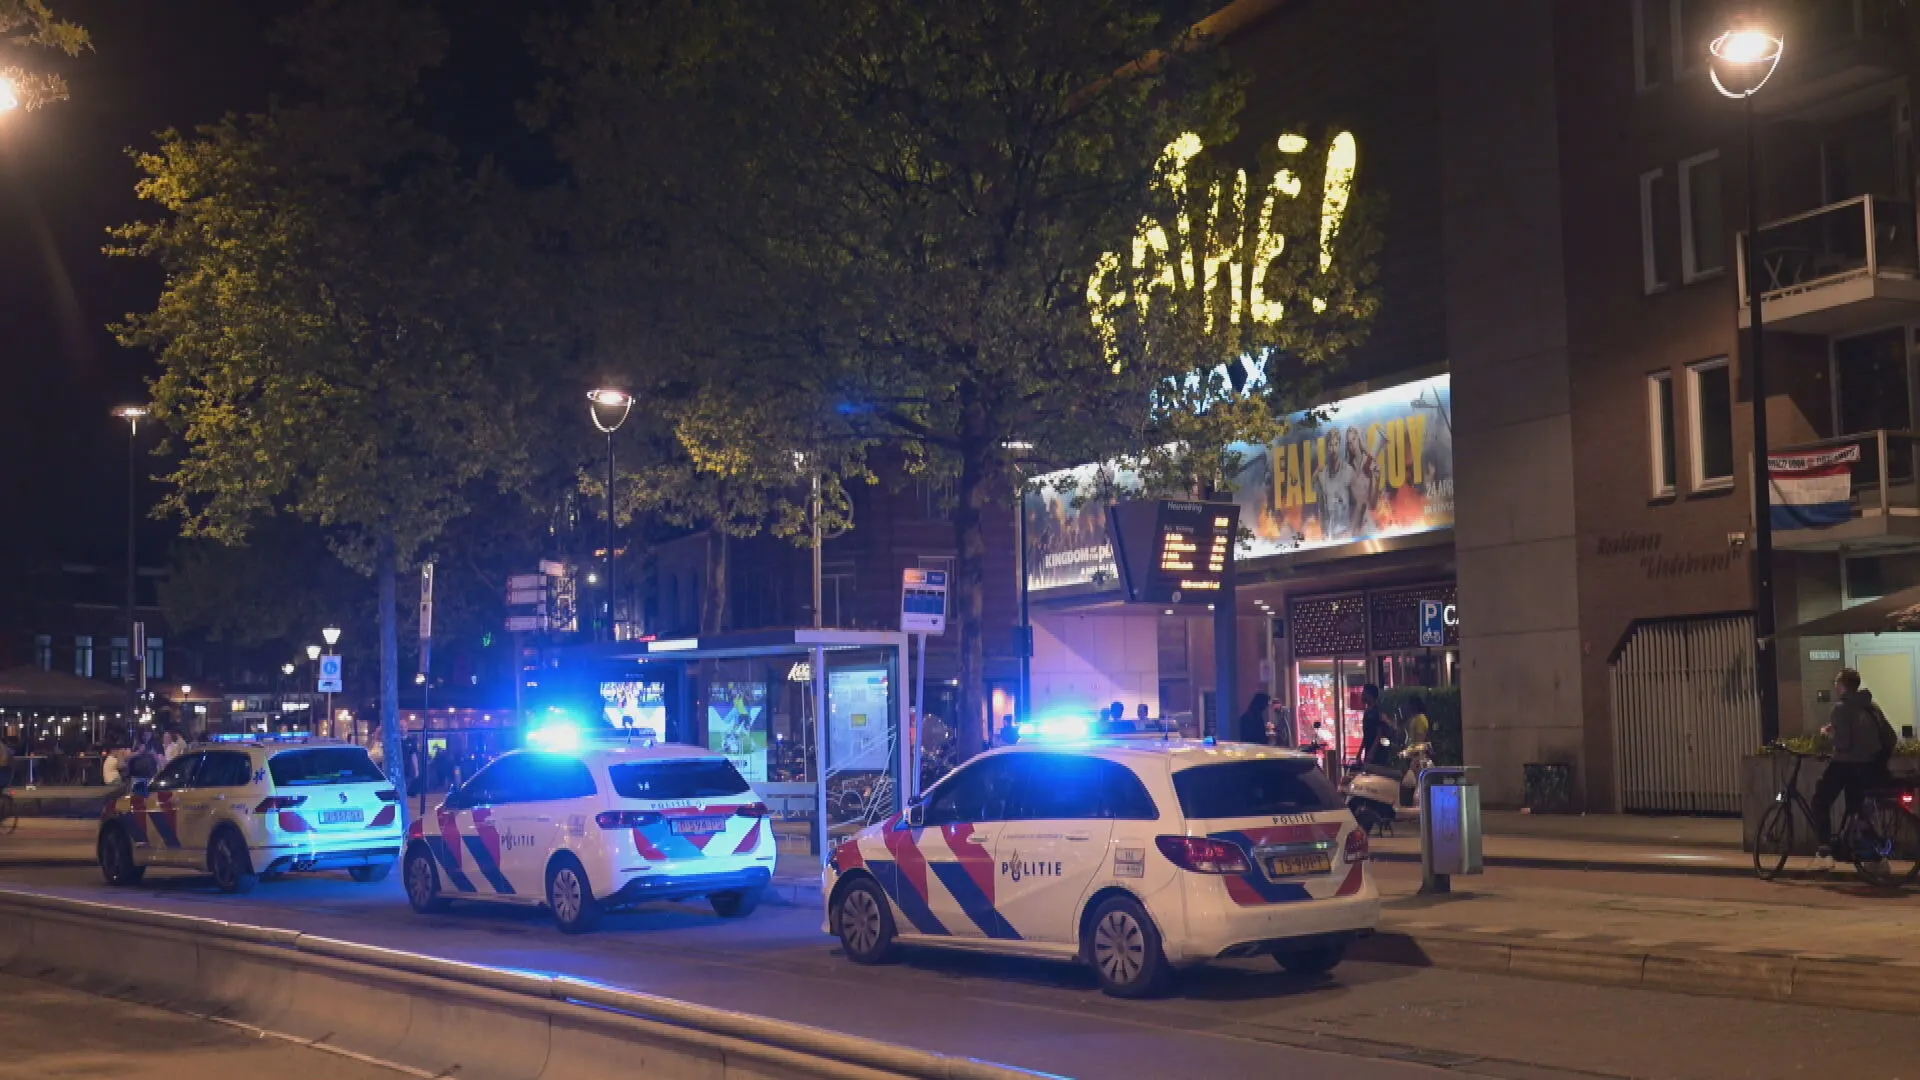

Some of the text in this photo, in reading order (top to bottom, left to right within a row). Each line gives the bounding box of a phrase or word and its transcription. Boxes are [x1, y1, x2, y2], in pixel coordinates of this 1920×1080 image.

[1045, 547, 1088, 569] KINGDOM
[1424, 603, 1438, 627] P
[1272, 813, 1316, 825] POLITIE
[501, 834, 535, 850] POLITIE
[1001, 858, 1063, 882] POLITIE
